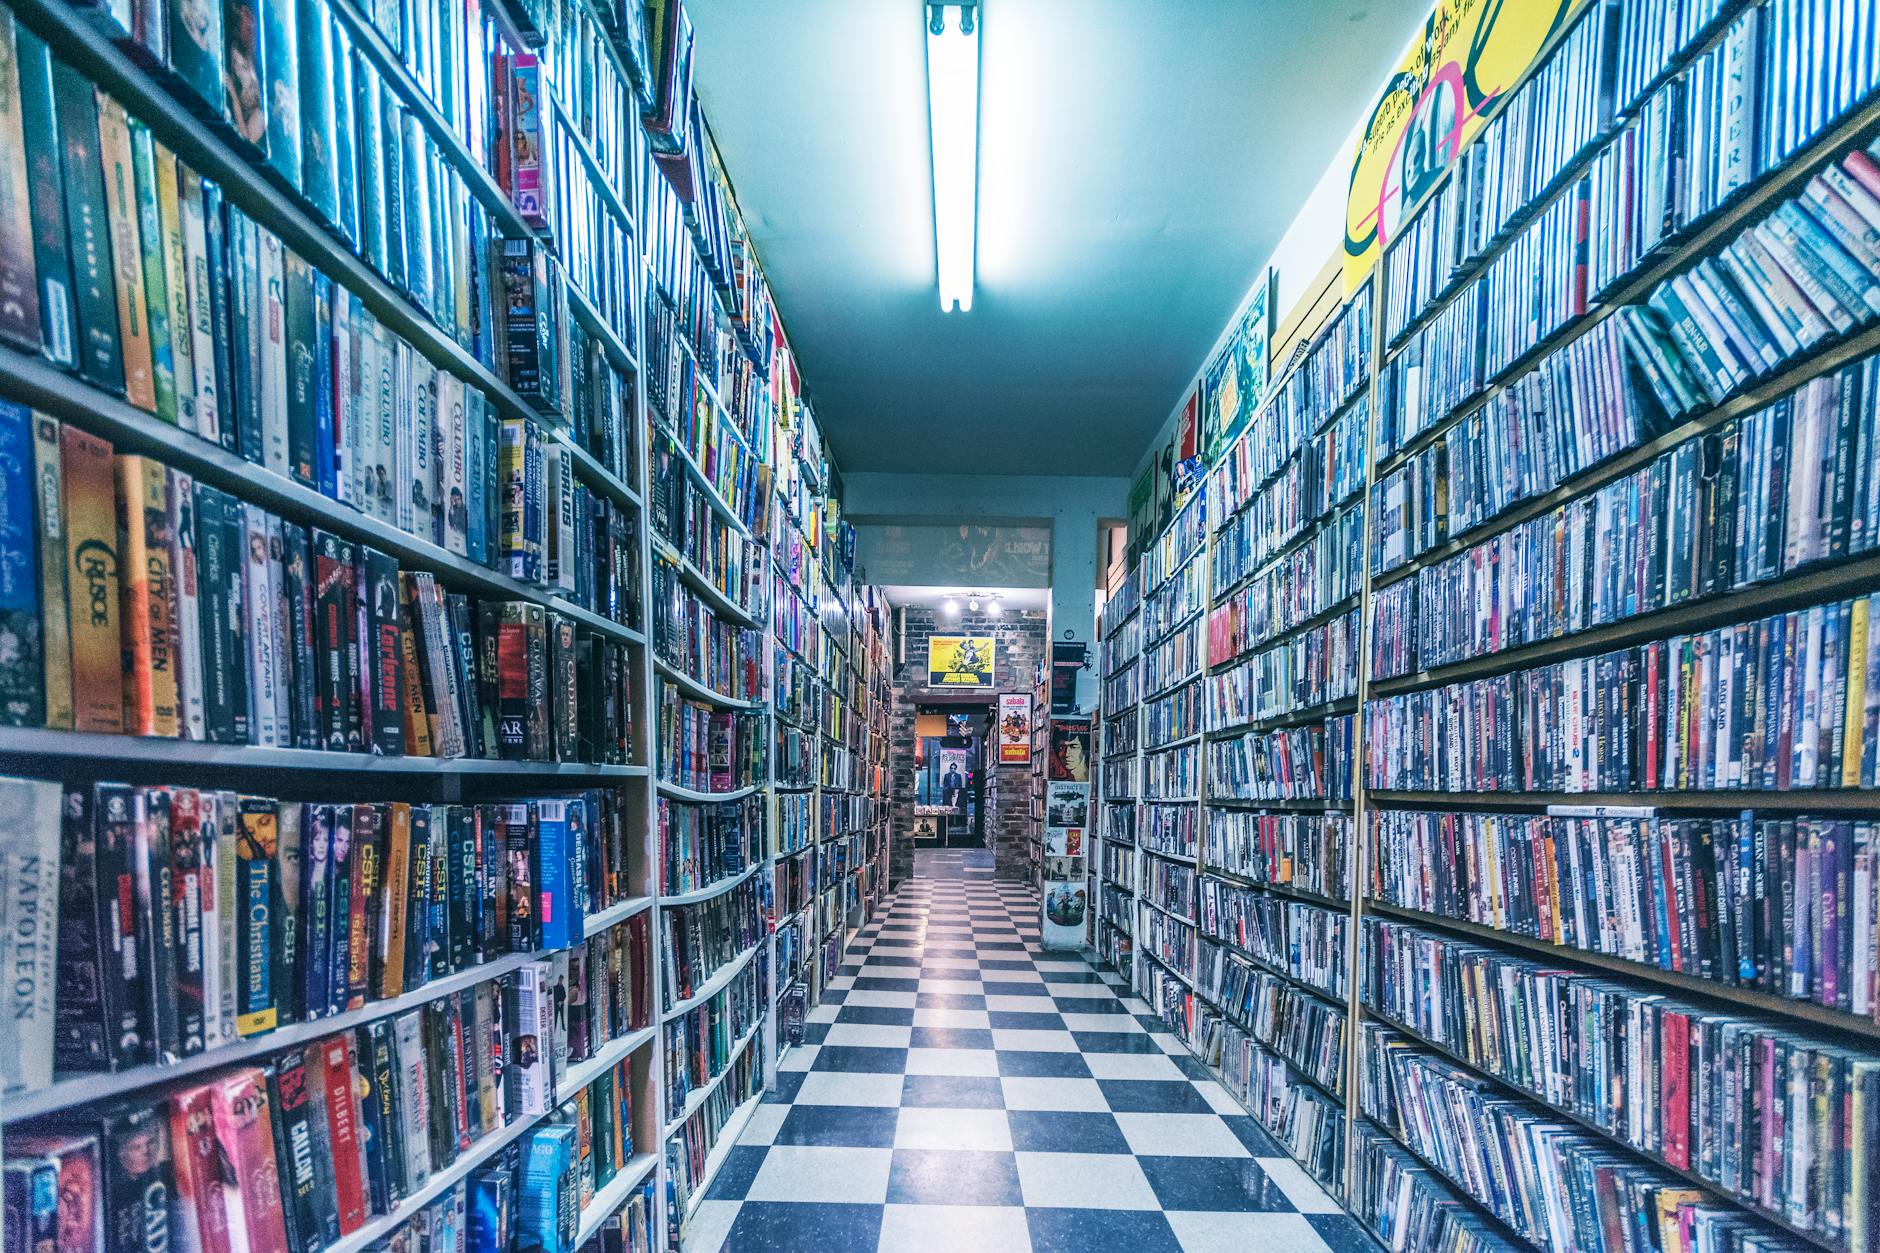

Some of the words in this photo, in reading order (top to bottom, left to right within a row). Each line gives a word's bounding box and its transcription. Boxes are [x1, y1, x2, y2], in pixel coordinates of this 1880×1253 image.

[1415, 44, 1425, 69] of
[1681, 316, 1708, 353] BEN-HUR
[382, 368, 391, 446] COLUMBO
[417, 383, 427, 469] COLUMBO
[453, 402, 462, 483] COLUMBO
[525, 449, 533, 505] COMMUNITY
[560, 450, 572, 528] CARLOS
[75, 538, 120, 627] CRUSOE
[148, 557, 164, 600] CITY
[207, 533, 221, 583] Clerks.
[259, 583, 270, 641] COVERT
[294, 595, 304, 663] COLUMBO
[152, 627, 168, 672] MEN
[264, 642, 273, 699] AFFAIRS
[331, 650, 340, 682] MINDS
[349, 642, 357, 677] MINDS
[381, 624, 399, 711] Corleone
[461, 632, 475, 681] CSI:
[486, 635, 496, 684] CSI:
[532, 639, 543, 678] CIVIL
[1854, 622, 1862, 681] BELOVED
[405, 637, 416, 665] CITY
[411, 684, 421, 714] MEN
[535, 679, 544, 706] WAR
[1769, 677, 1778, 711] STRIPED
[1836, 677, 1844, 694] THE
[567, 659, 577, 742] CADFAEL
[1718, 680, 1727, 730] BADLAND
[1834, 695, 1844, 726] BROWN
[500, 720, 524, 735] AR
[1832, 728, 1843, 758] BUNNY
[1572, 749, 1579, 759] 2
[362, 844, 372, 896] CSI:
[463, 840, 475, 885] CSI:
[575, 832, 583, 888] DEGRASSI
[1593, 847, 1601, 883] COUNTRY
[1632, 827, 1641, 874] CINCINNATI
[1731, 844, 1740, 894] CAMERA
[1756, 832, 1764, 860] CLEAN
[250, 864, 267, 898] The
[416, 844, 425, 898] CSI:
[437, 858, 445, 901] CSI:
[1510, 847, 1519, 896] COASTLINES
[1535, 842, 1545, 902] CAMILLE
[1684, 862, 1694, 910] CHANGELING
[1716, 872, 1726, 897] CHINESE
[1740, 867, 1749, 896] Clue
[1756, 873, 1764, 899] SOBER
[160, 866, 172, 948] COLUMBO
[186, 874, 197, 932] CRIMINAL
[316, 879, 326, 938] CSI:
[1718, 897, 1727, 924] COFFEE
[14, 854, 41, 1022] NAPOLEON
[188, 933, 200, 972] MINDS
[250, 903, 268, 993] Christians
[284, 915, 296, 965] CSI:
[1726, 1071, 1734, 1095] DEATH
[333, 1086, 351, 1144] DILBERT
[1726, 1097, 1734, 1122] WATCH
[290, 1119, 312, 1185] CALLAN
